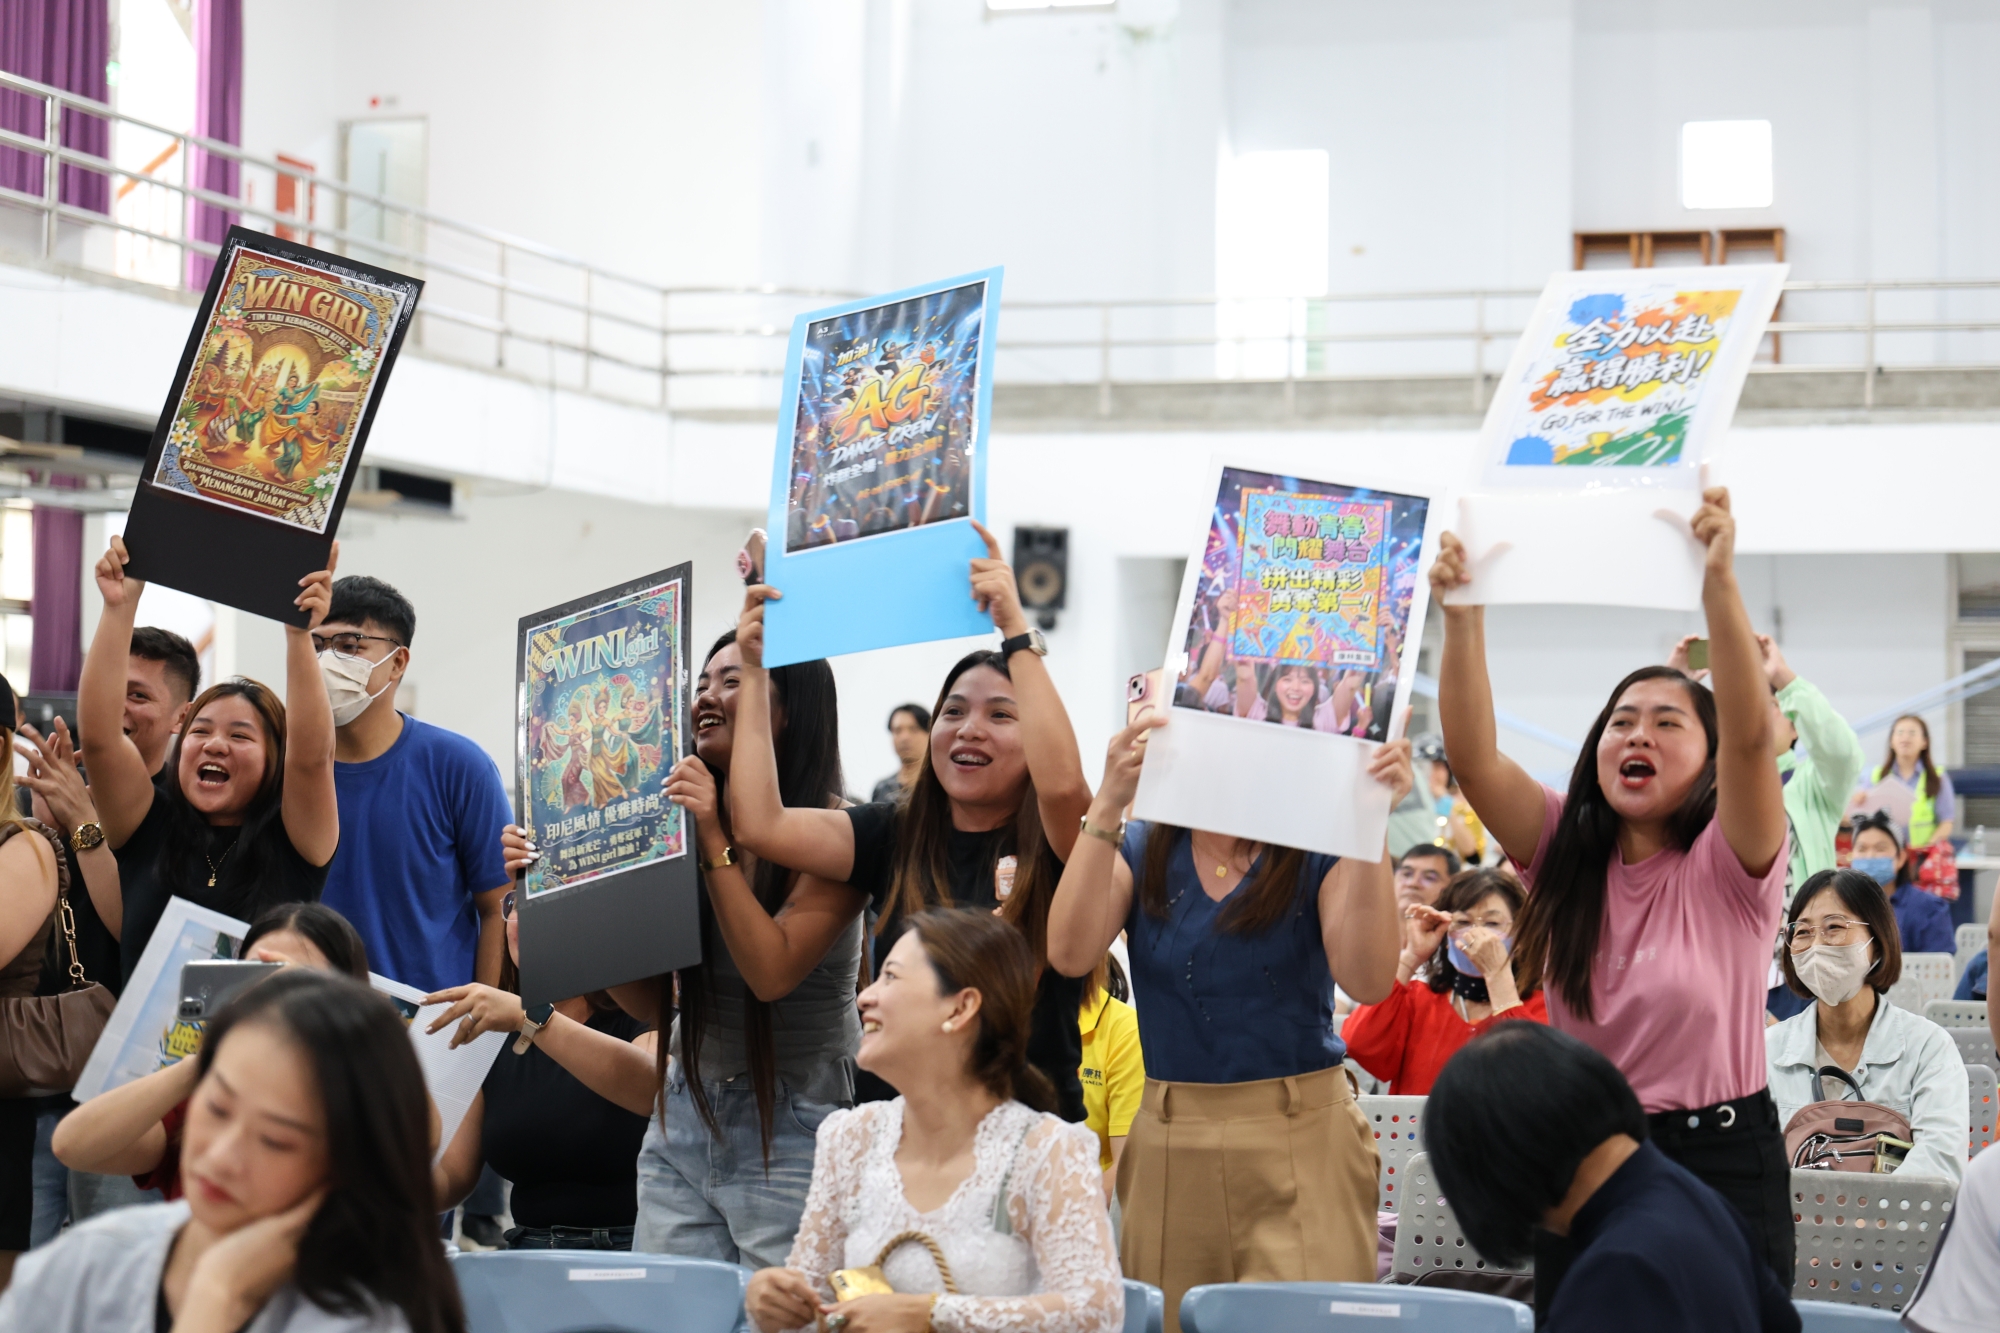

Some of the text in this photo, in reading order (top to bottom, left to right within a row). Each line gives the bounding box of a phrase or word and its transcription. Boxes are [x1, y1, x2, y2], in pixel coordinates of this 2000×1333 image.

[240, 273, 373, 347] WIN GIRL
[251, 313, 266, 321] TIM
[267, 313, 284, 322] TARI
[1565, 312, 1716, 356] 全力以赴
[837, 363, 932, 443] AG
[1541, 397, 1687, 430] GO FOR THE WIN!
[827, 410, 940, 469] DANCE CREW
[199, 474, 288, 509] MENANGKAN JUARA!
[1263, 509, 1366, 540] 舞動青春
[1272, 536, 1371, 563] 閃耀舞台
[1261, 566, 1363, 591] 拼出精彩
[541, 626, 659, 683] WINI girl
[546, 793, 660, 840] 印尼風情 優雅時尚
